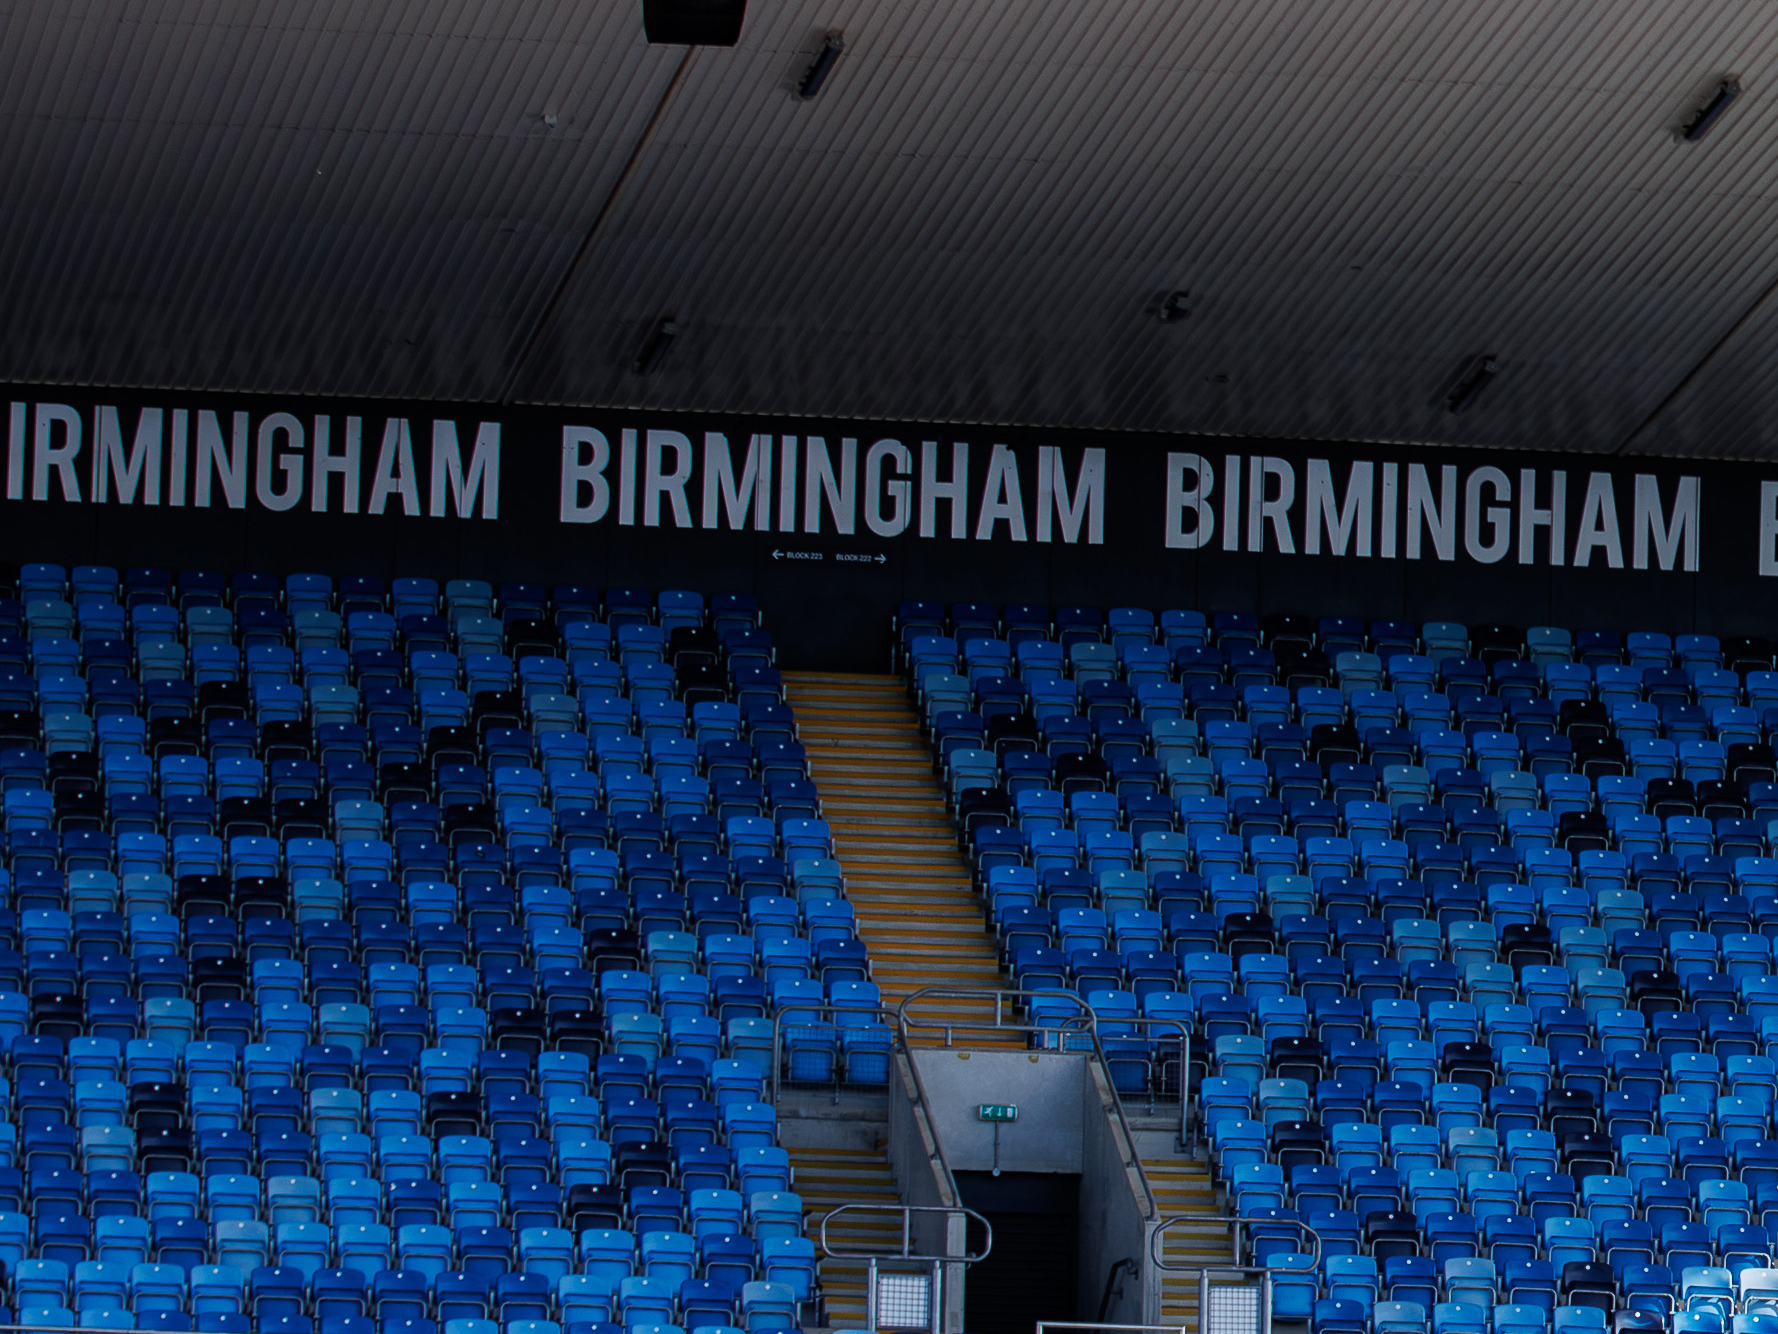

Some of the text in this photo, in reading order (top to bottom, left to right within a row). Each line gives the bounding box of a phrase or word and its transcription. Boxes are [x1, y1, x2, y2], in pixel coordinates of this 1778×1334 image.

[6, 402, 501, 520] IRMINGHAM
[560, 425, 1106, 545] BIRMINGHAM
[1165, 452, 1701, 572] BIRMINGHAM
[786, 551, 823, 560] BLOCK 223
[835, 553, 872, 562] BLOCK 222
